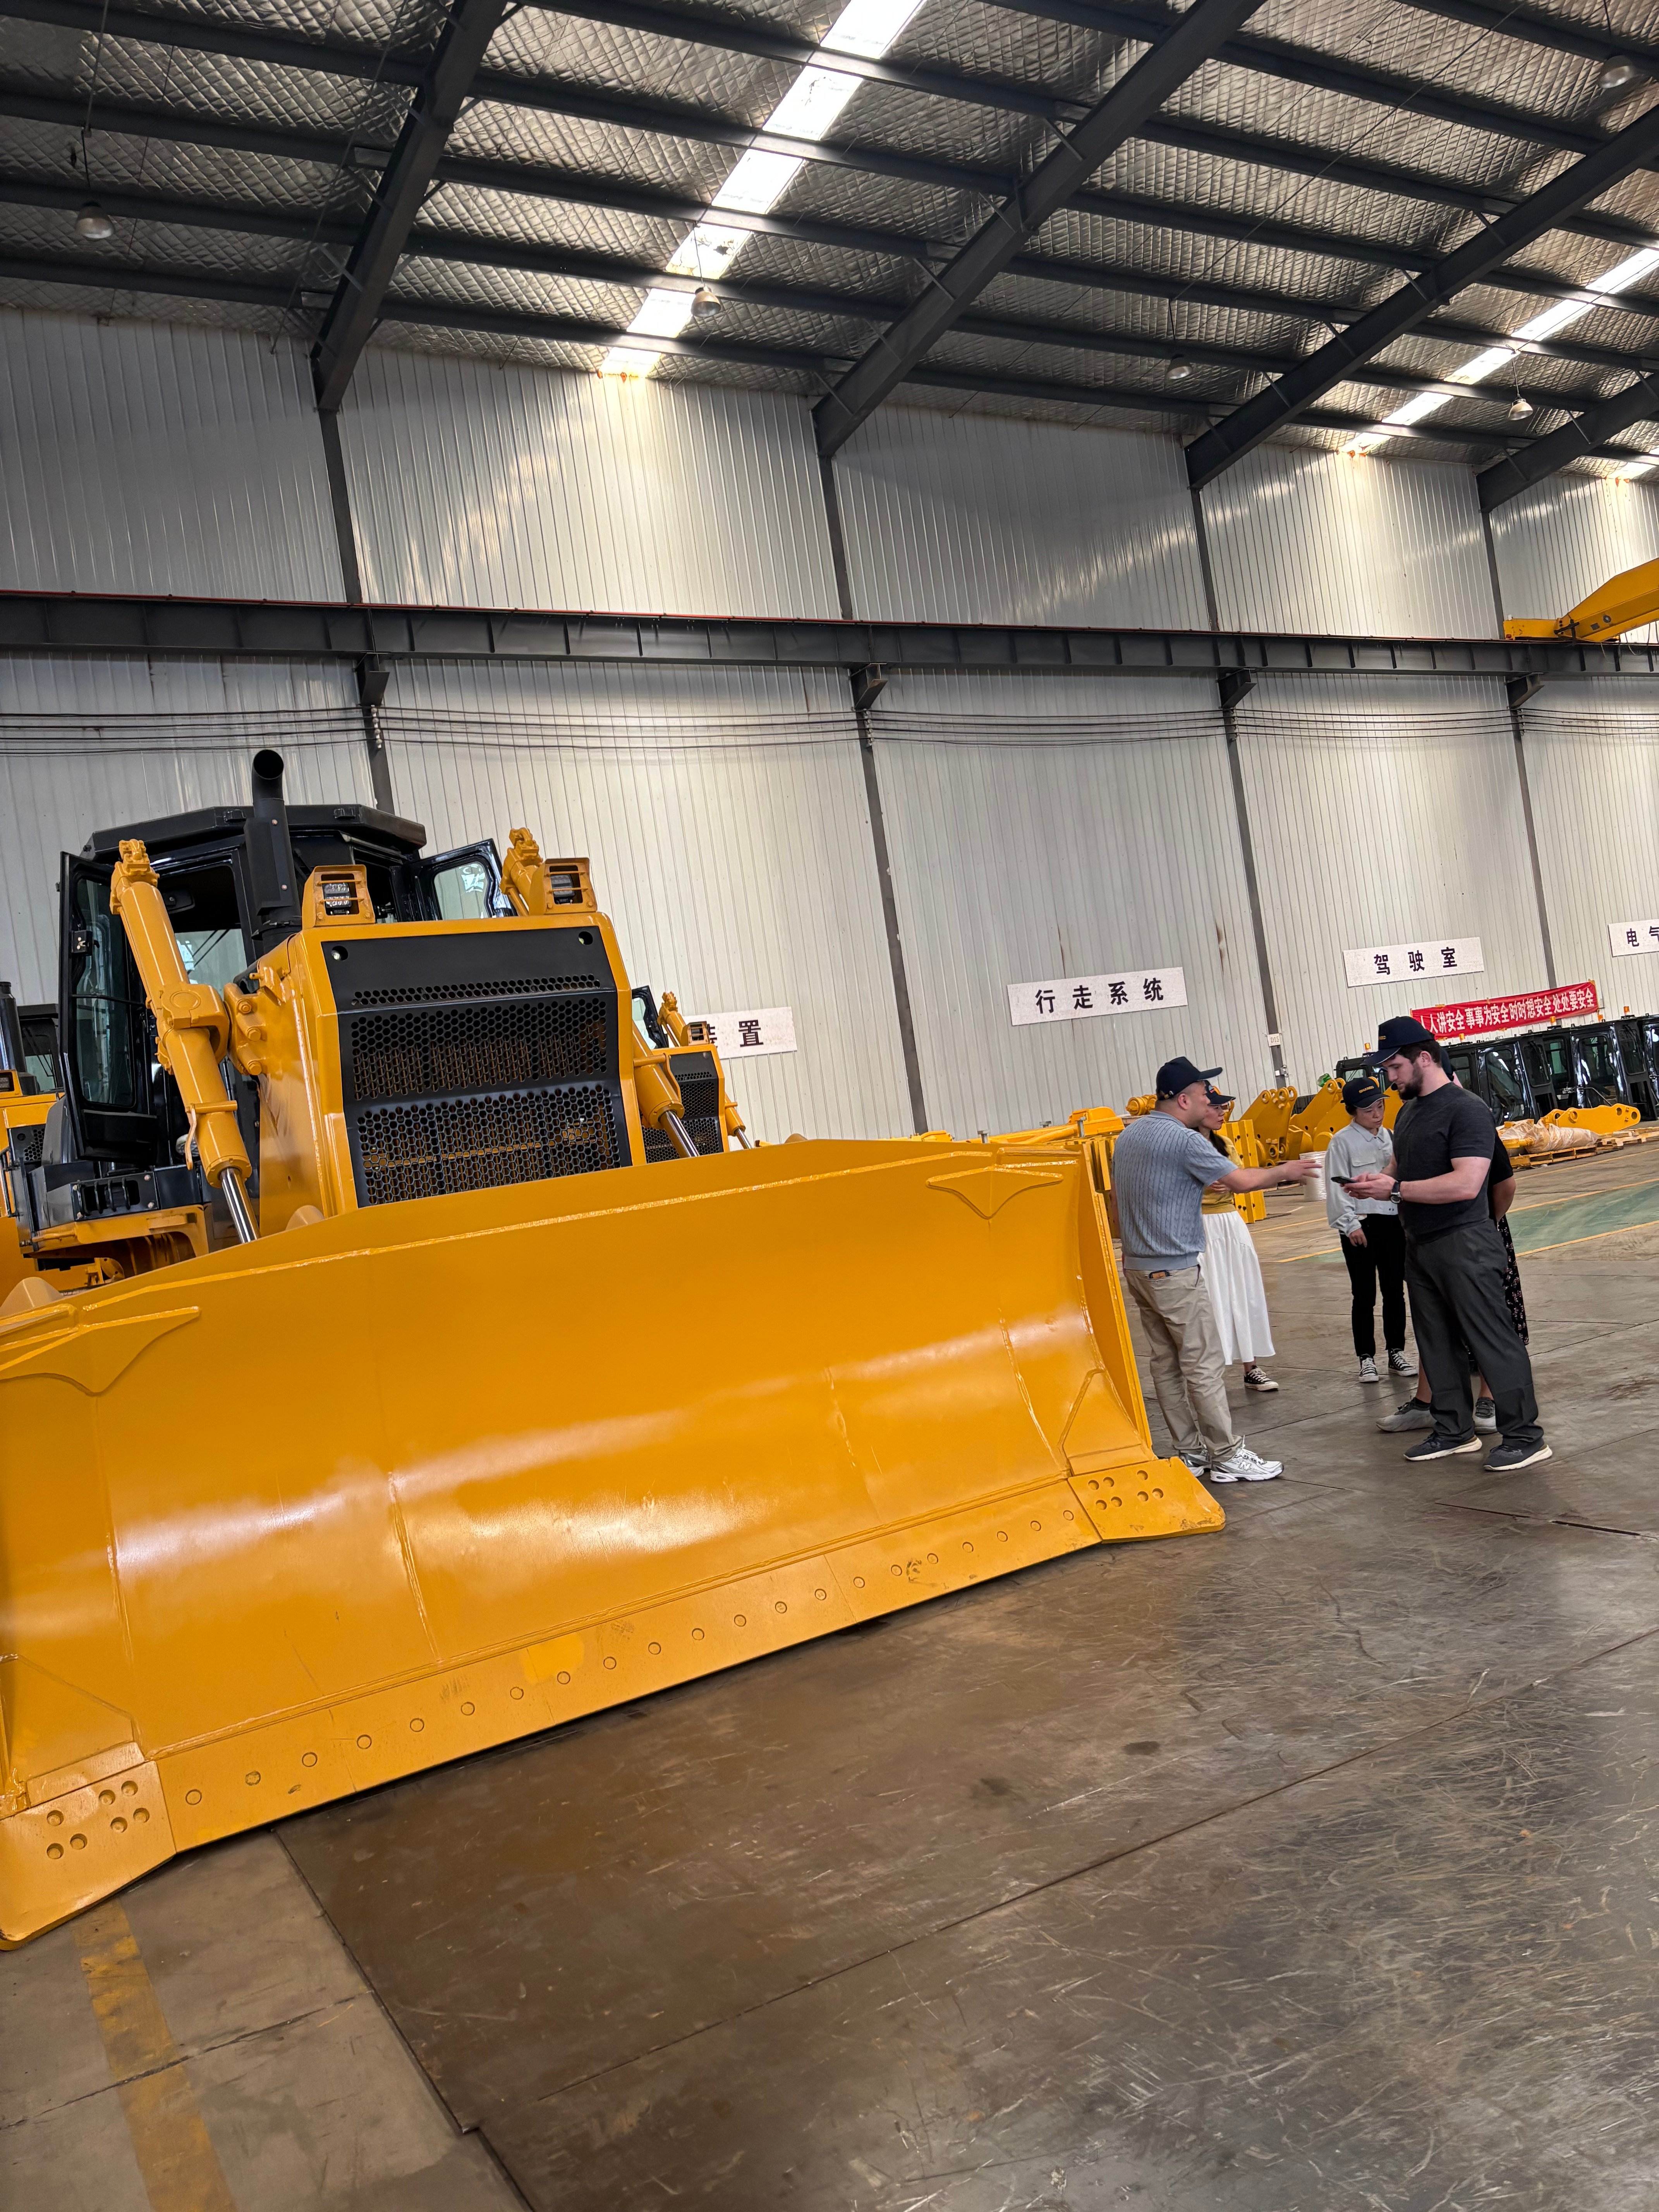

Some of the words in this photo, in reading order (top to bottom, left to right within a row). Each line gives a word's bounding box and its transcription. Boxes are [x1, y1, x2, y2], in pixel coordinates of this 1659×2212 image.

[1626, 926, 1659, 947] 电气
[1374, 946, 1458, 975] 驾驶室
[1035, 977, 1164, 1014] 行走系统
